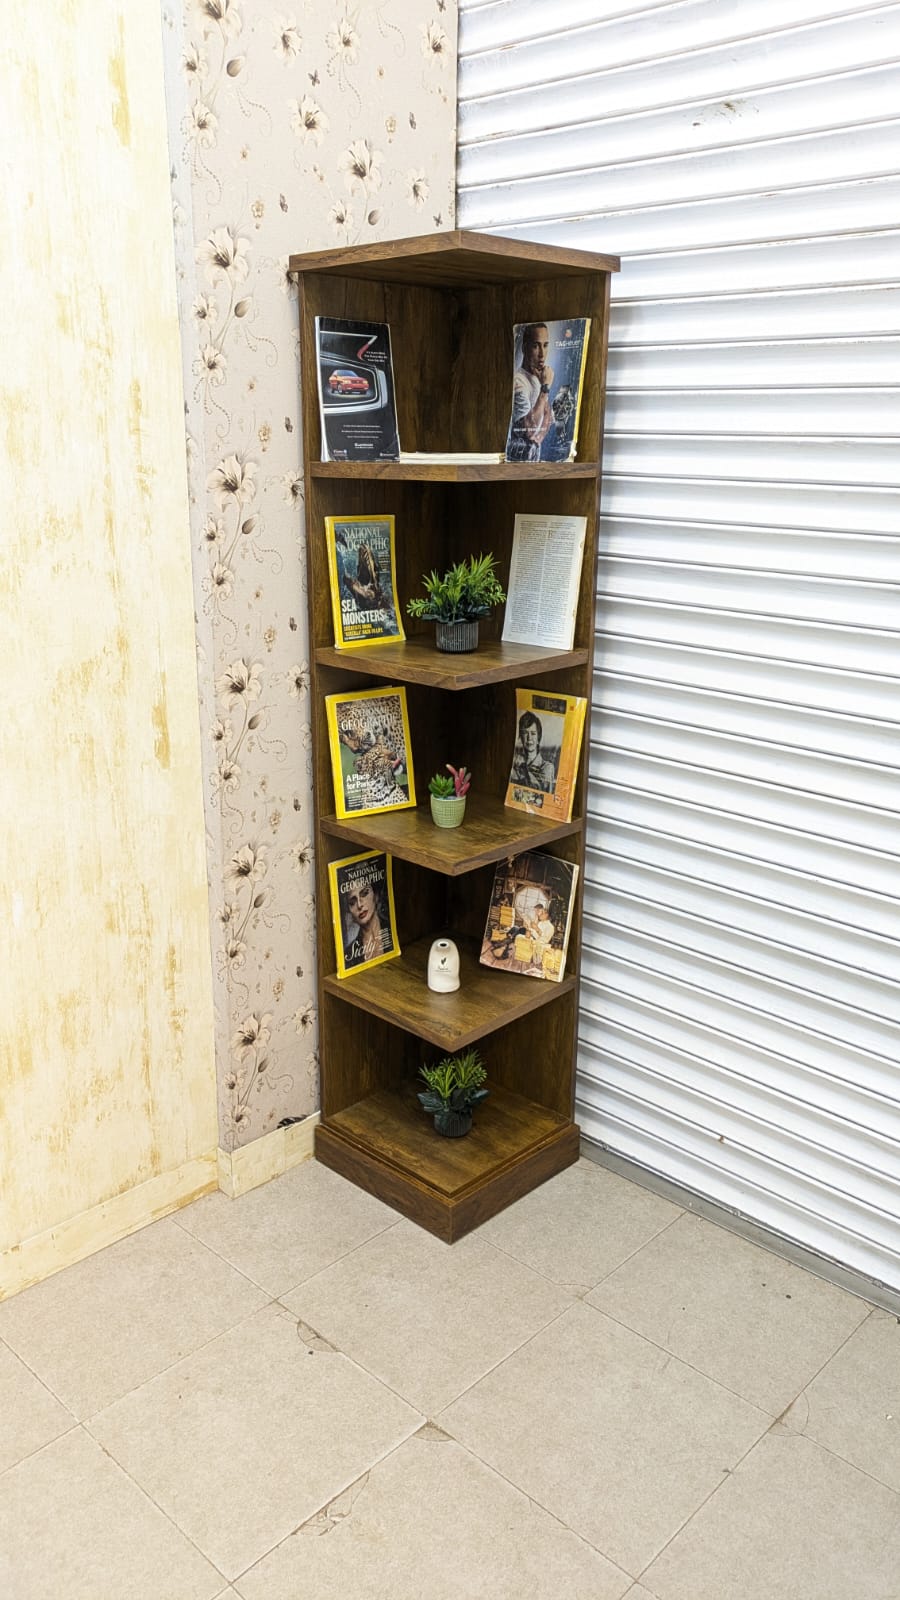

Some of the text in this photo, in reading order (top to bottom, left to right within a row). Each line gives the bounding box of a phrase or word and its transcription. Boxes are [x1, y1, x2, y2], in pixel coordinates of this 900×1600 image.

[344, 526, 382, 539] NATIONAL
[341, 598, 357, 613] SEA
[342, 608, 385, 625] MONSTERS
[346, 774, 352, 783] A
[348, 864, 378, 880] NATIONAL
[340, 869, 385, 894] GEOGRAPHIC
[344, 935, 376, 961] Sicily
